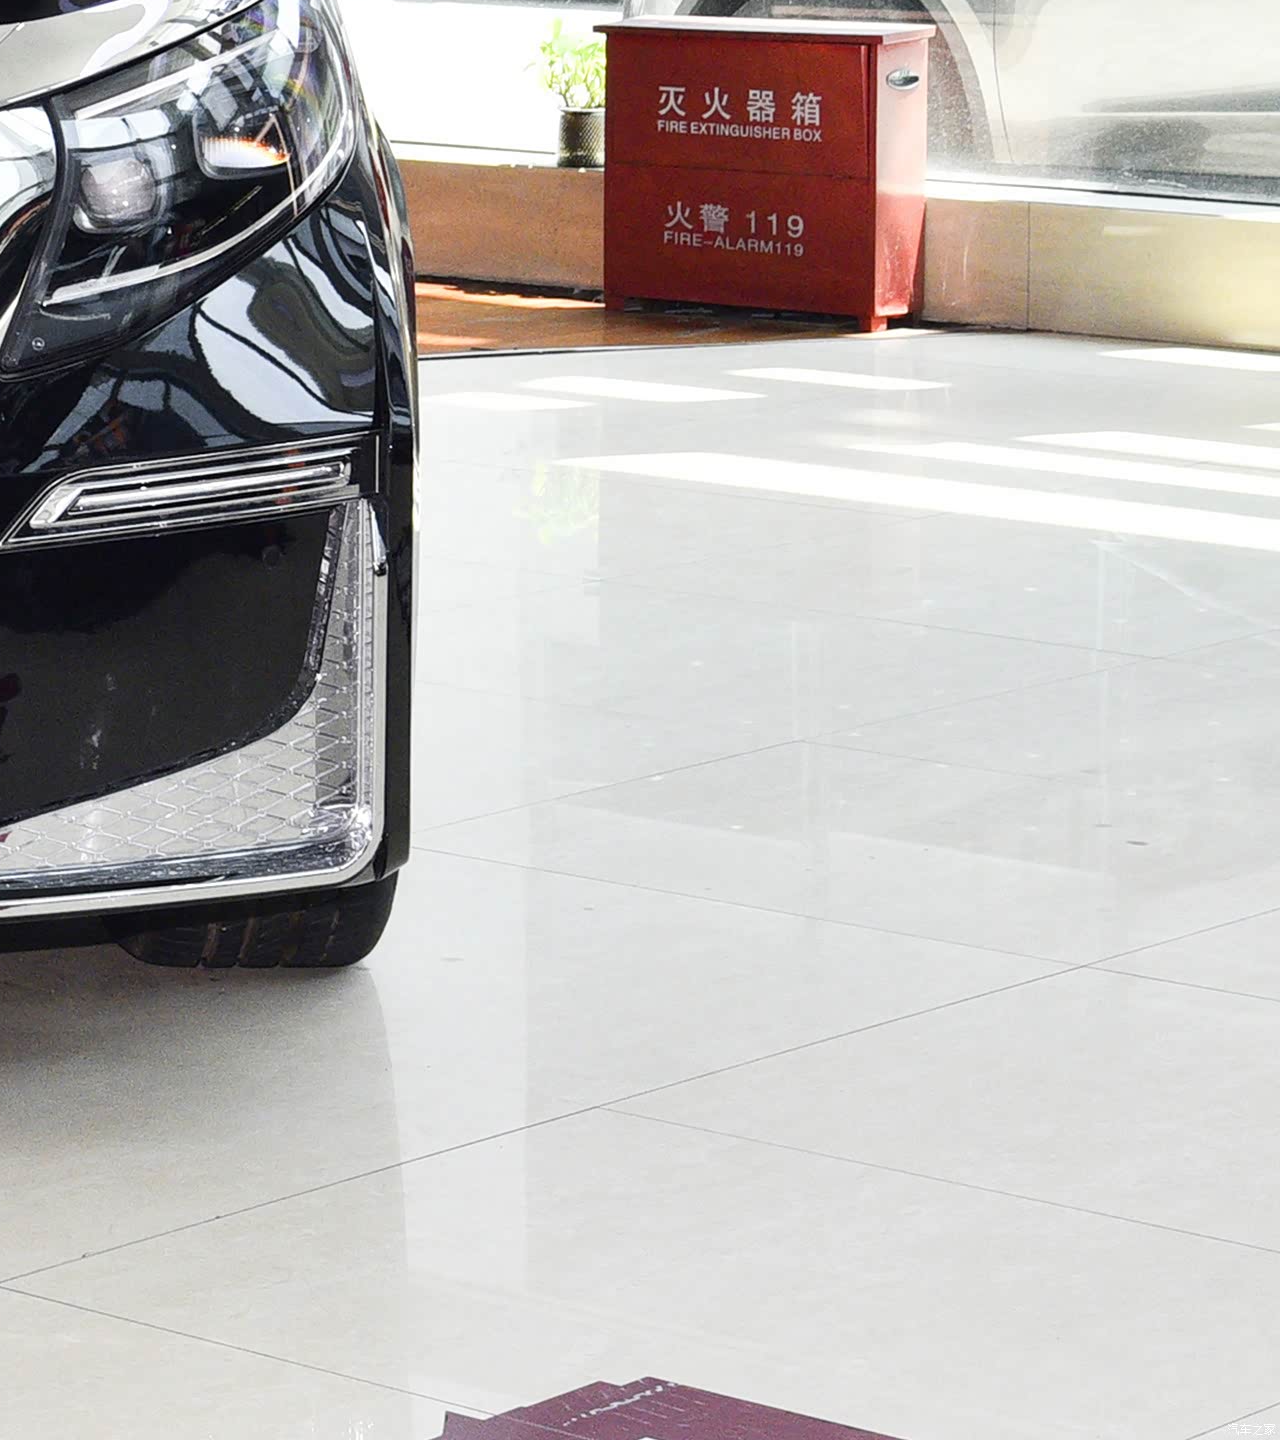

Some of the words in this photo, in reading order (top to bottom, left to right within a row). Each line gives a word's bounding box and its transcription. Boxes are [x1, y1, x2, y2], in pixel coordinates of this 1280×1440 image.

[658, 85, 822, 126] 灭火器箱
[656, 119, 688, 135] FIRE
[689, 121, 791, 141] EXTINGUISHER
[792, 127, 823, 143] BOX
[663, 200, 729, 235] 火警
[744, 210, 805, 240] 119
[663, 231, 805, 257] FIRE-ALARM119
